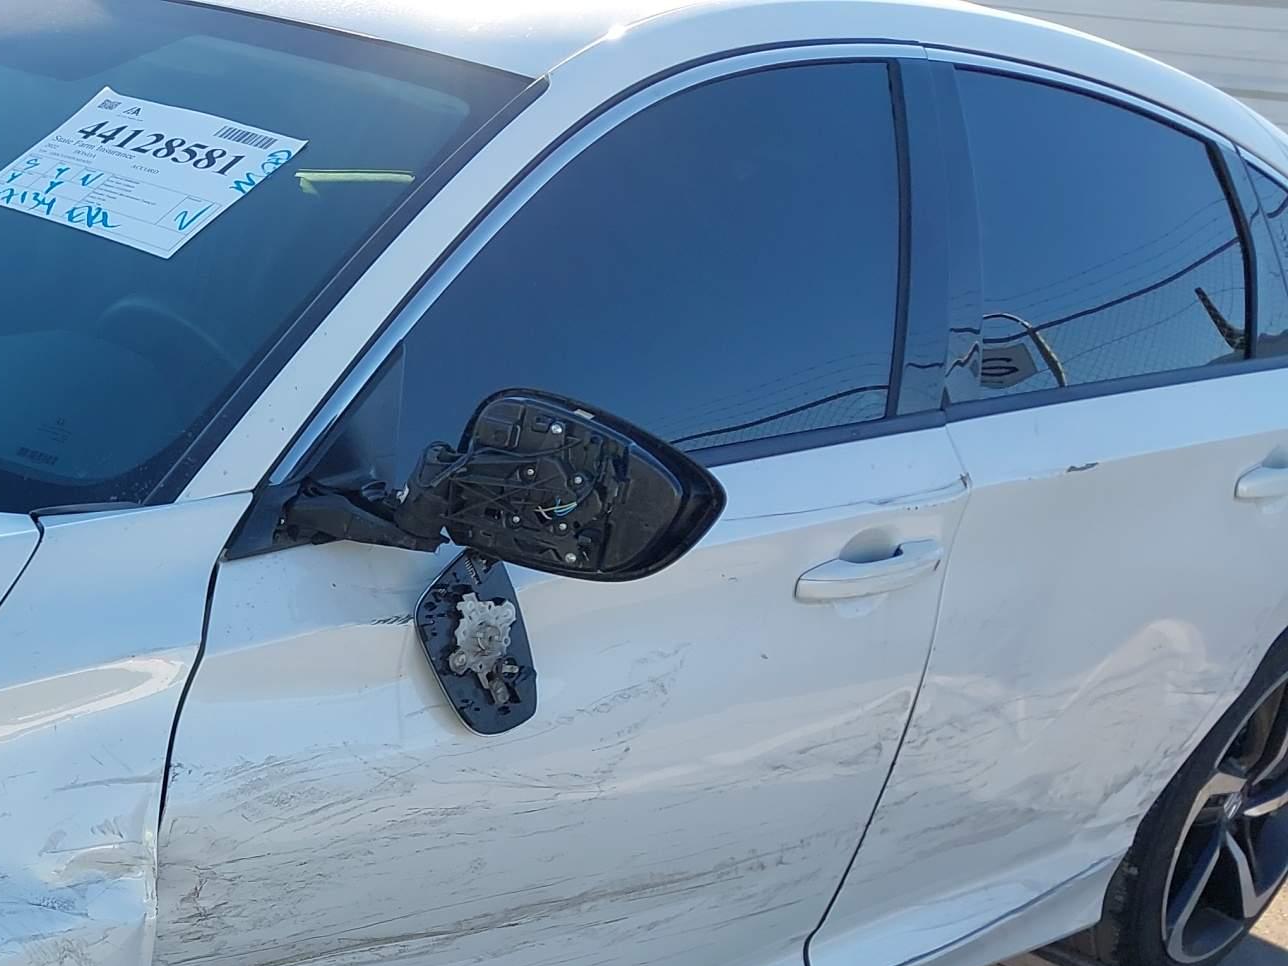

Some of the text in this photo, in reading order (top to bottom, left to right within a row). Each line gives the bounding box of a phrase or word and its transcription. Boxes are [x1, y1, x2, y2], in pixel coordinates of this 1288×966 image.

[54, 135, 74, 146] State
[73, 140, 93, 152] Farm
[95, 144, 136, 161] Insurance
[78, 120, 245, 177] 44128581
